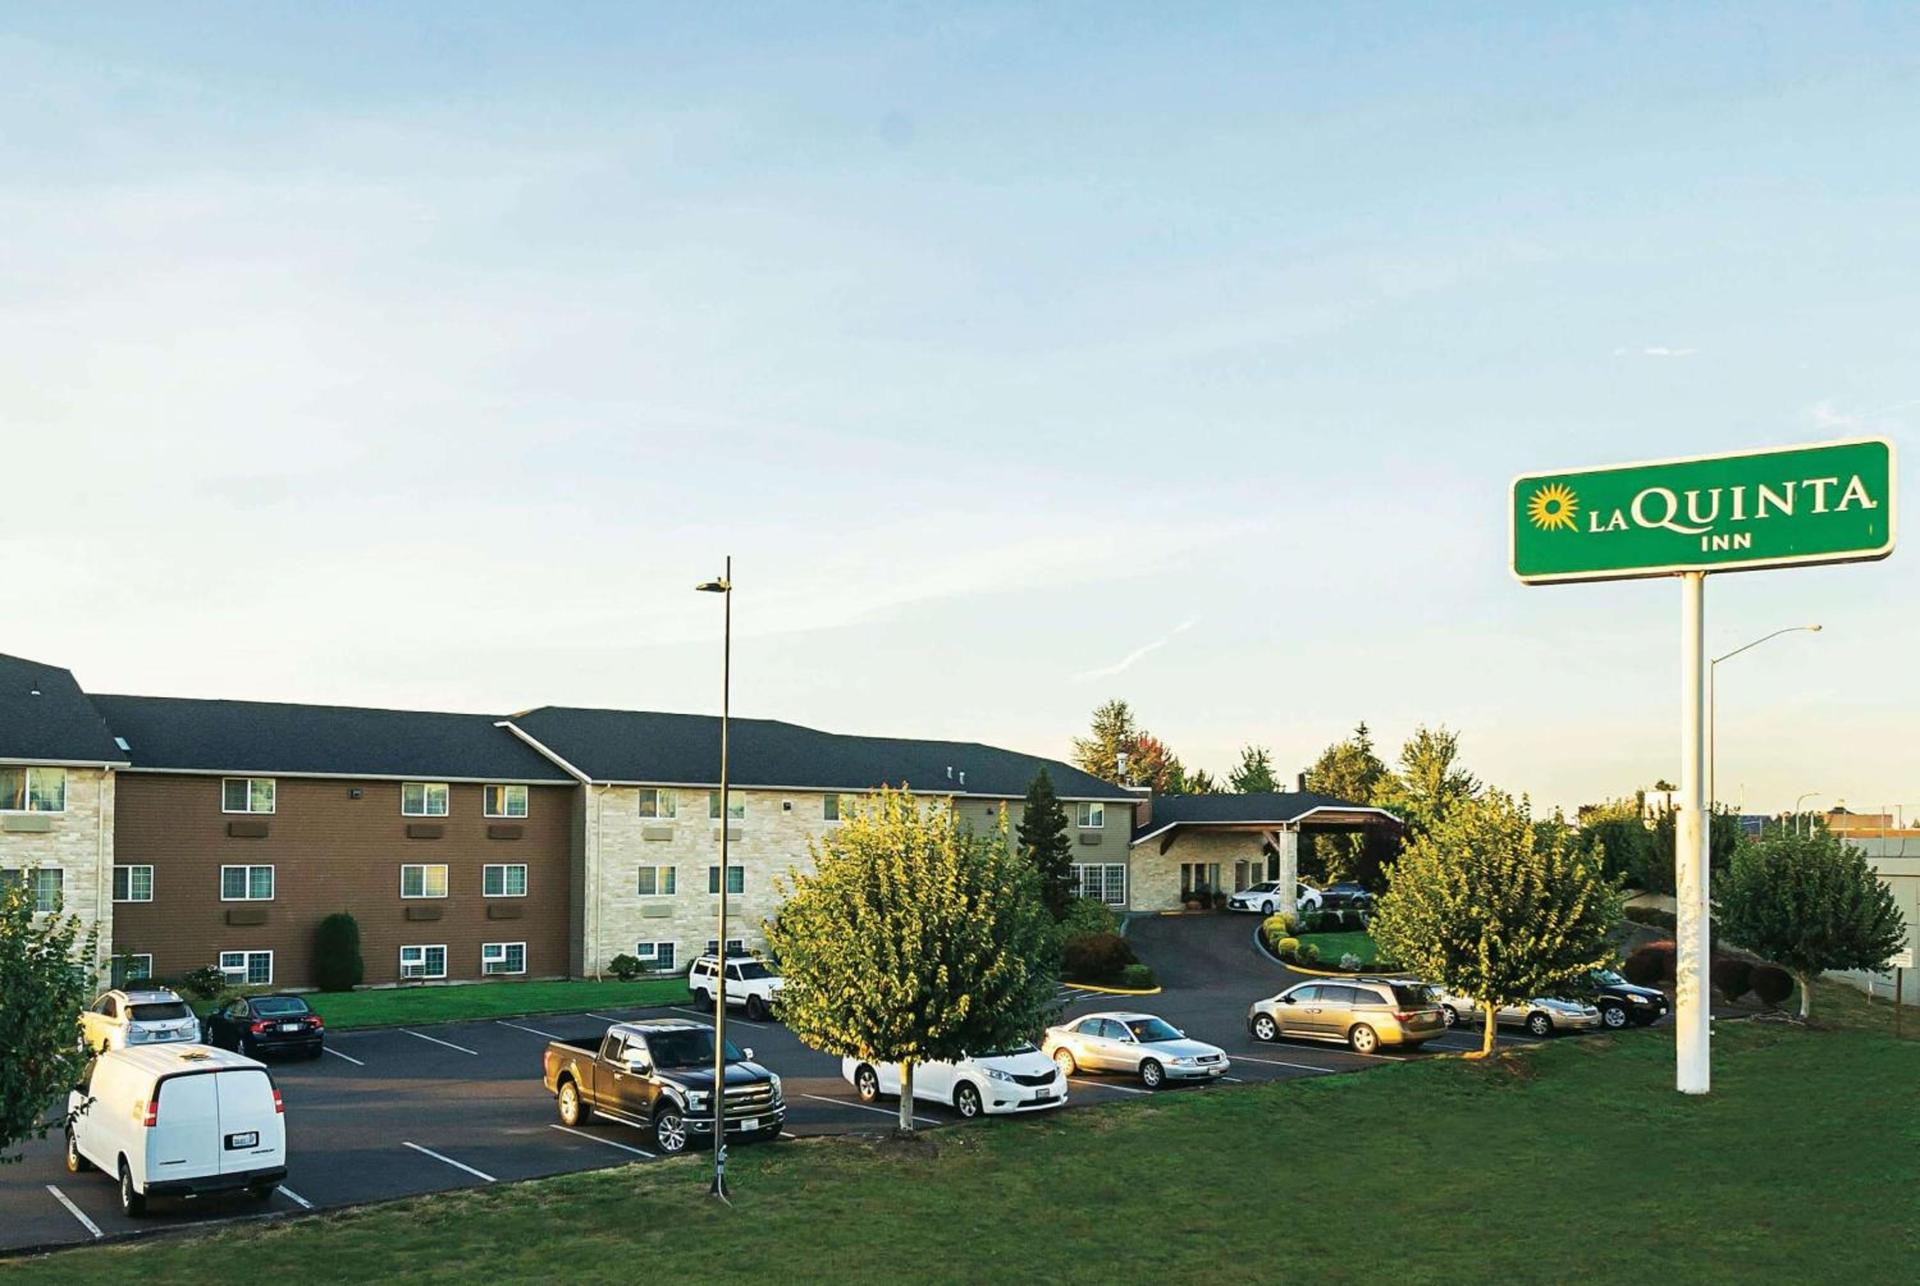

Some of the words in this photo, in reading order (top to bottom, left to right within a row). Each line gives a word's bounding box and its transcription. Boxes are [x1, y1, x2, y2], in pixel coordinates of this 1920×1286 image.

[1589, 509, 1629, 532] LA
[1630, 474, 1876, 534] QUINTA
[1702, 533, 1752, 552] INN
